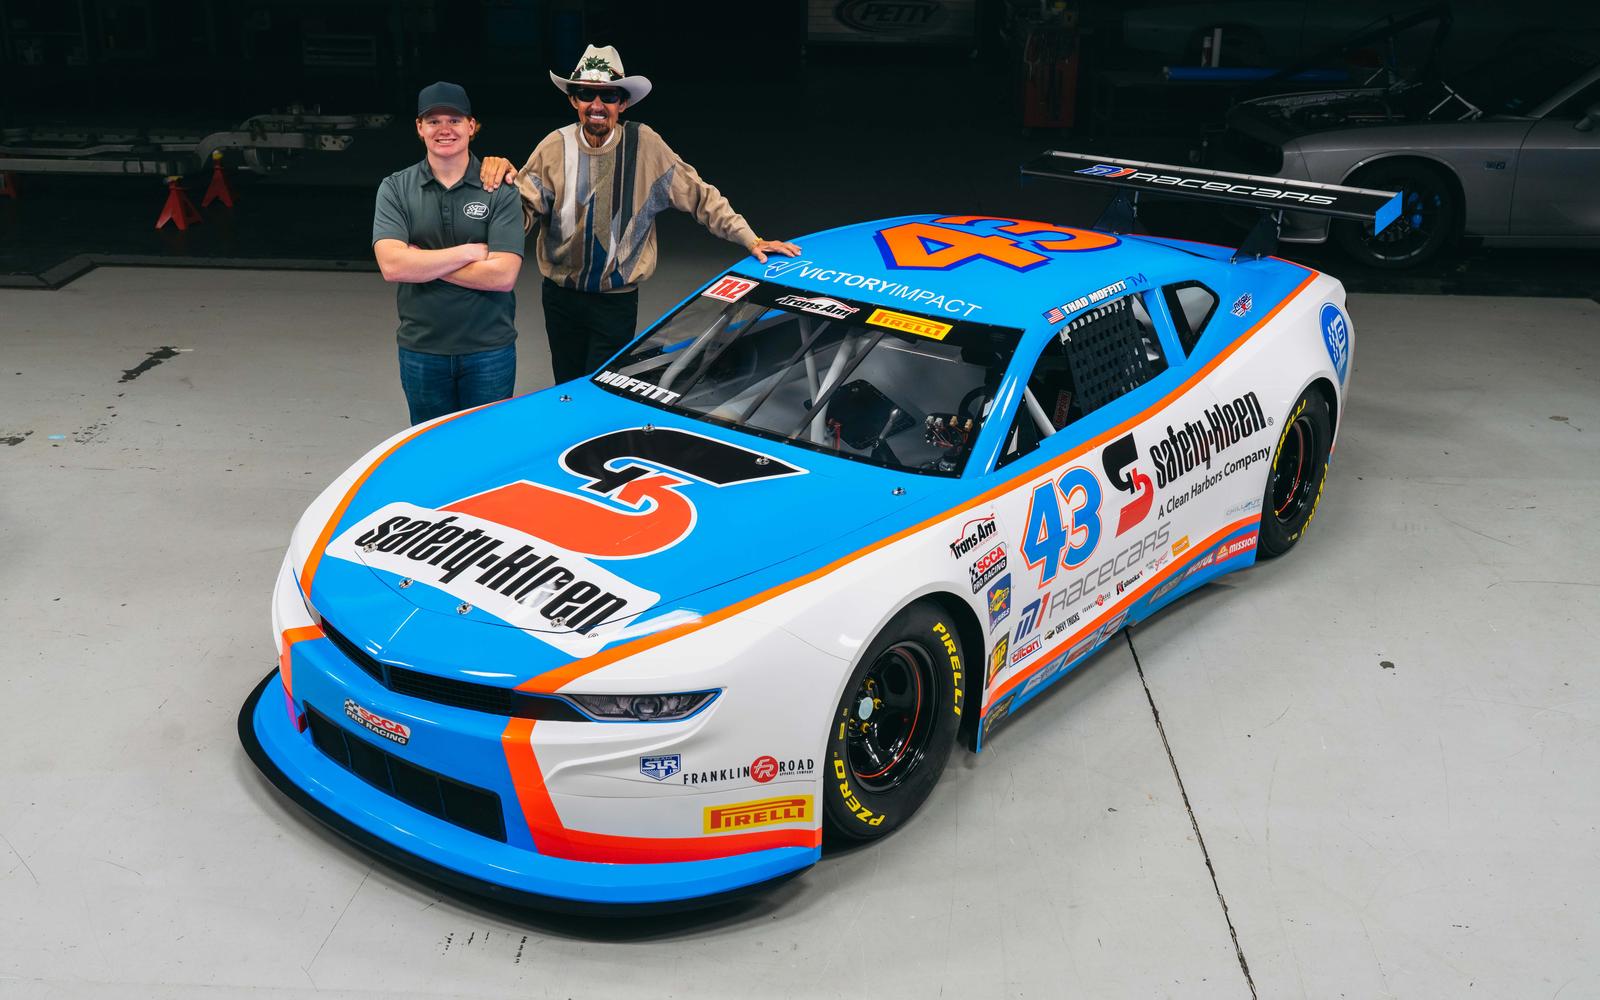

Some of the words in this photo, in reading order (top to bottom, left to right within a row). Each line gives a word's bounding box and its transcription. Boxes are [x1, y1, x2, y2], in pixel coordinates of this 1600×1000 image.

[860, 3, 941, 22] PETTY
[873, 215, 1122, 273] 43
[709, 277, 753, 300] TA2
[1060, 295, 1089, 315] THAD
[1088, 279, 1127, 304] MOFFITT
[778, 296, 824, 310] Trans
[821, 304, 851, 317] Am
[874, 311, 946, 338] PIRELLI
[594, 370, 681, 404] MOFFITT
[1149, 391, 1267, 489] safety-kleen
[1158, 505, 1165, 520] A
[1167, 494, 1189, 514] Clean
[1190, 473, 1222, 506] Harbors
[1223, 446, 1271, 477] Company
[949, 533, 978, 560] Trans
[976, 520, 997, 542] Am
[1020, 466, 1103, 589] 43
[977, 547, 1005, 573] SCCA
[973, 578, 984, 593] PRO
[983, 560, 1006, 584] RACING
[1055, 621, 1067, 634] CHEVY
[1066, 612, 1080, 628] TRUCKS
[933, 622, 963, 717] PIRELLI
[346, 709, 364, 724] PRO
[366, 722, 406, 745] RACING
[358, 707, 408, 737] SCCA
[642, 760, 678, 770] SLR
[683, 766, 750, 784] FRANKLIN
[779, 759, 814, 773] ROAD
[711, 799, 807, 829] PIRELLI
